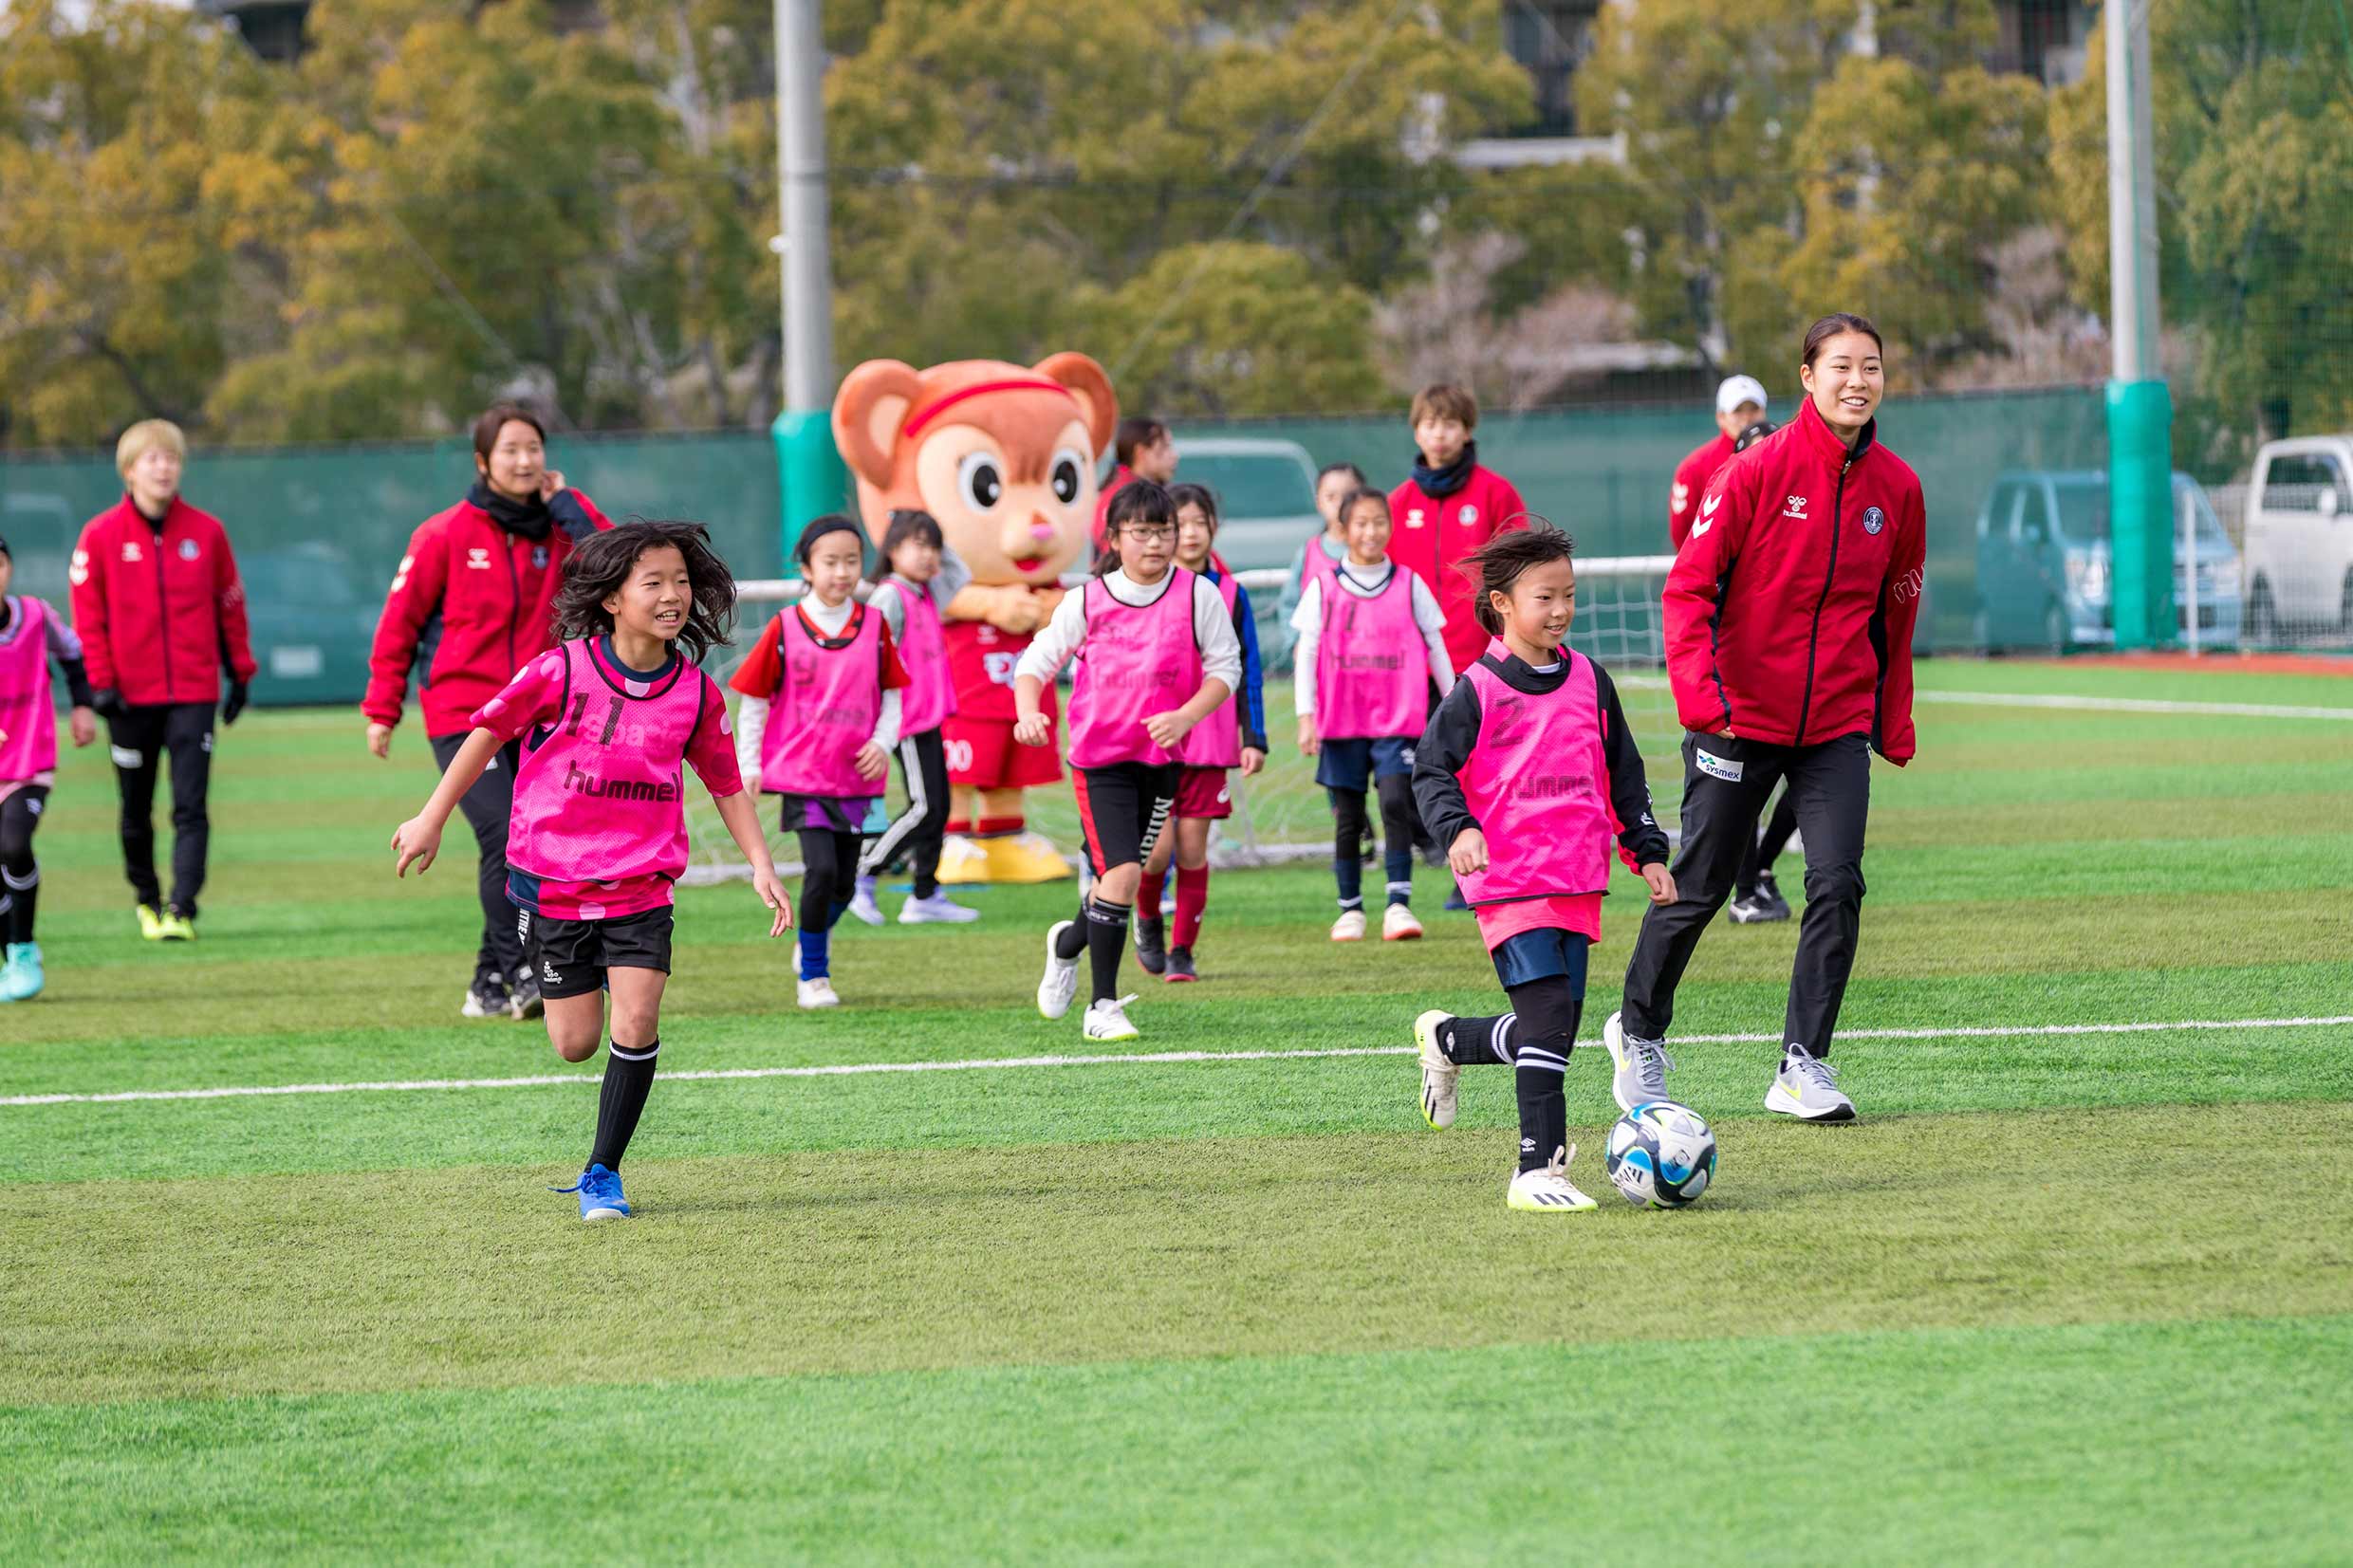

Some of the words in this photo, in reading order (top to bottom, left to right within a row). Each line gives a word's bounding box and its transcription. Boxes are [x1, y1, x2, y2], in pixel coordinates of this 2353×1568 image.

[1329, 649, 1406, 670] hummel
[565, 692, 625, 746] 11
[1490, 696, 1525, 749] 2
[564, 760, 681, 803] hummel
[1507, 771, 1597, 799] umme
